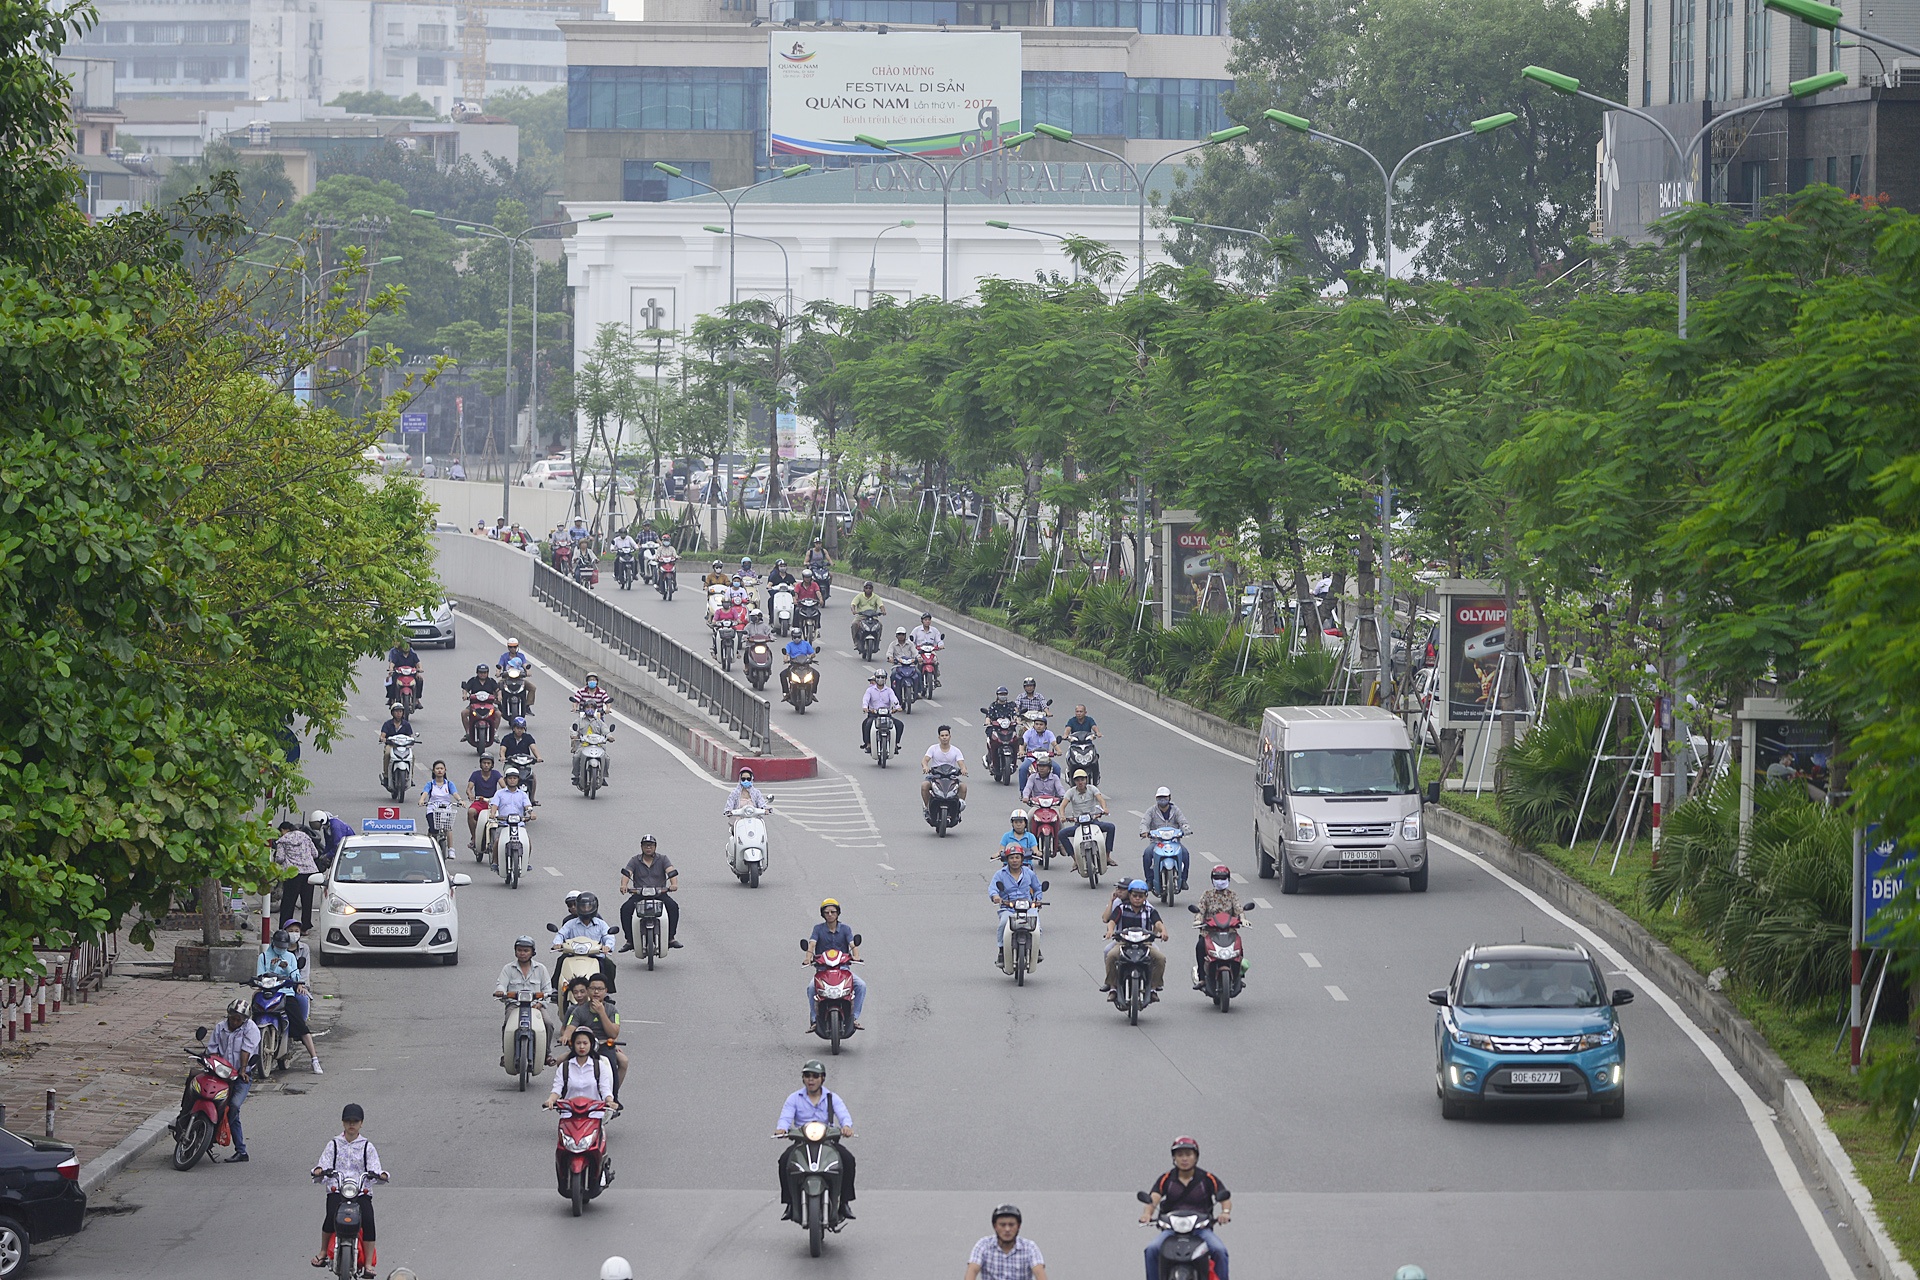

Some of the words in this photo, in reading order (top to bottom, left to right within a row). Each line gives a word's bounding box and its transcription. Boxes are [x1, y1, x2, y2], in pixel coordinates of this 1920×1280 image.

[871, 65, 901, 76] CHÀO
[902, 65, 935, 76] MỪNG
[845, 82, 914, 93] FESTIVAL
[919, 82, 933, 93] DI
[936, 78, 966, 93] SẢN
[805, 95, 867, 110] QUẢNG
[872, 98, 910, 109] NAM
[964, 99, 993, 109] 2017
[1016, 162, 1142, 193] PALACE
[1660, 182, 1672, 208] BAC
[1677, 181, 1694, 207] BNK
[1460, 609, 1507, 622] OLYMPI
